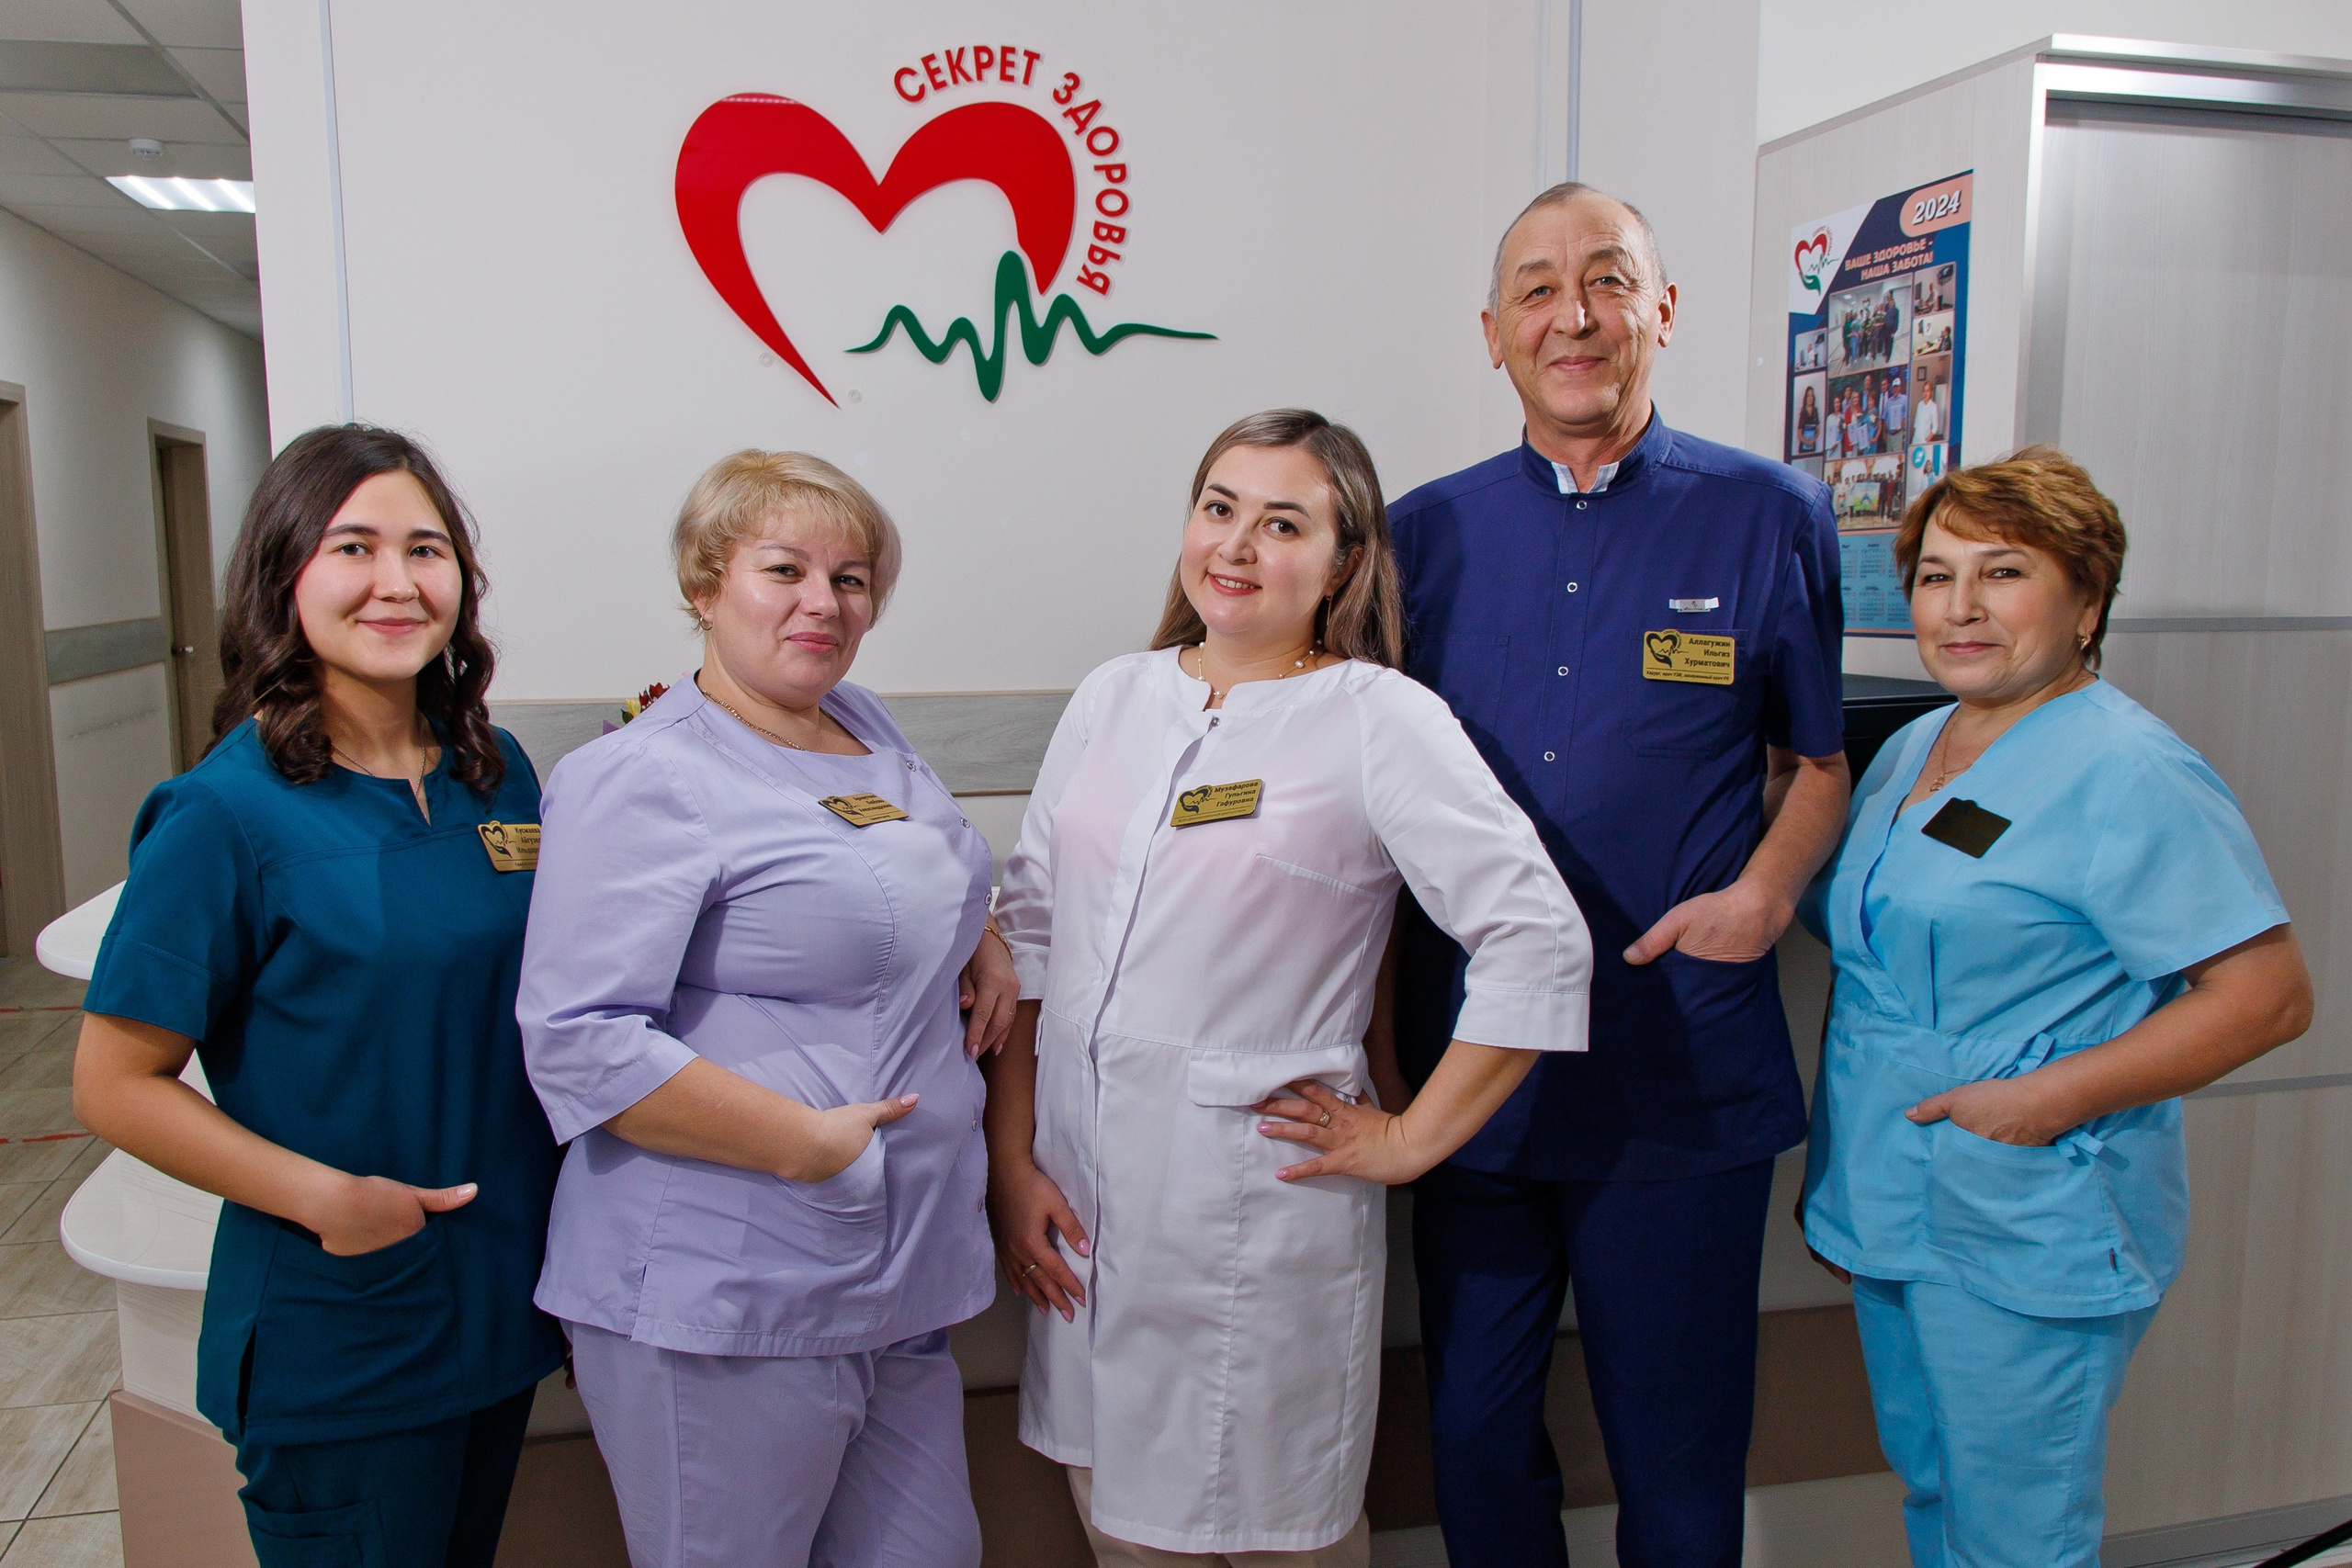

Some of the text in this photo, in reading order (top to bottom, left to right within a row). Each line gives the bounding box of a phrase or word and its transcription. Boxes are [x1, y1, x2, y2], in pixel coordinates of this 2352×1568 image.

[894, 46, 1129, 296] СЕКРЕТ ЗДОРОВЬЯ
[1911, 190, 1962, 225] 2024
[1845, 252, 1872, 271] ВАШЕ
[1872, 237, 1928, 264] ЗДОРОВЬЕ
[1860, 251, 1934, 281] НАША ЗАБОТА!
[1684, 658, 1730, 668] Хурматович
[1703, 649, 1730, 658] Ильгиз
[1214, 782, 1259, 794] Музафарова
[1216, 796, 1254, 807] Гафуровна
